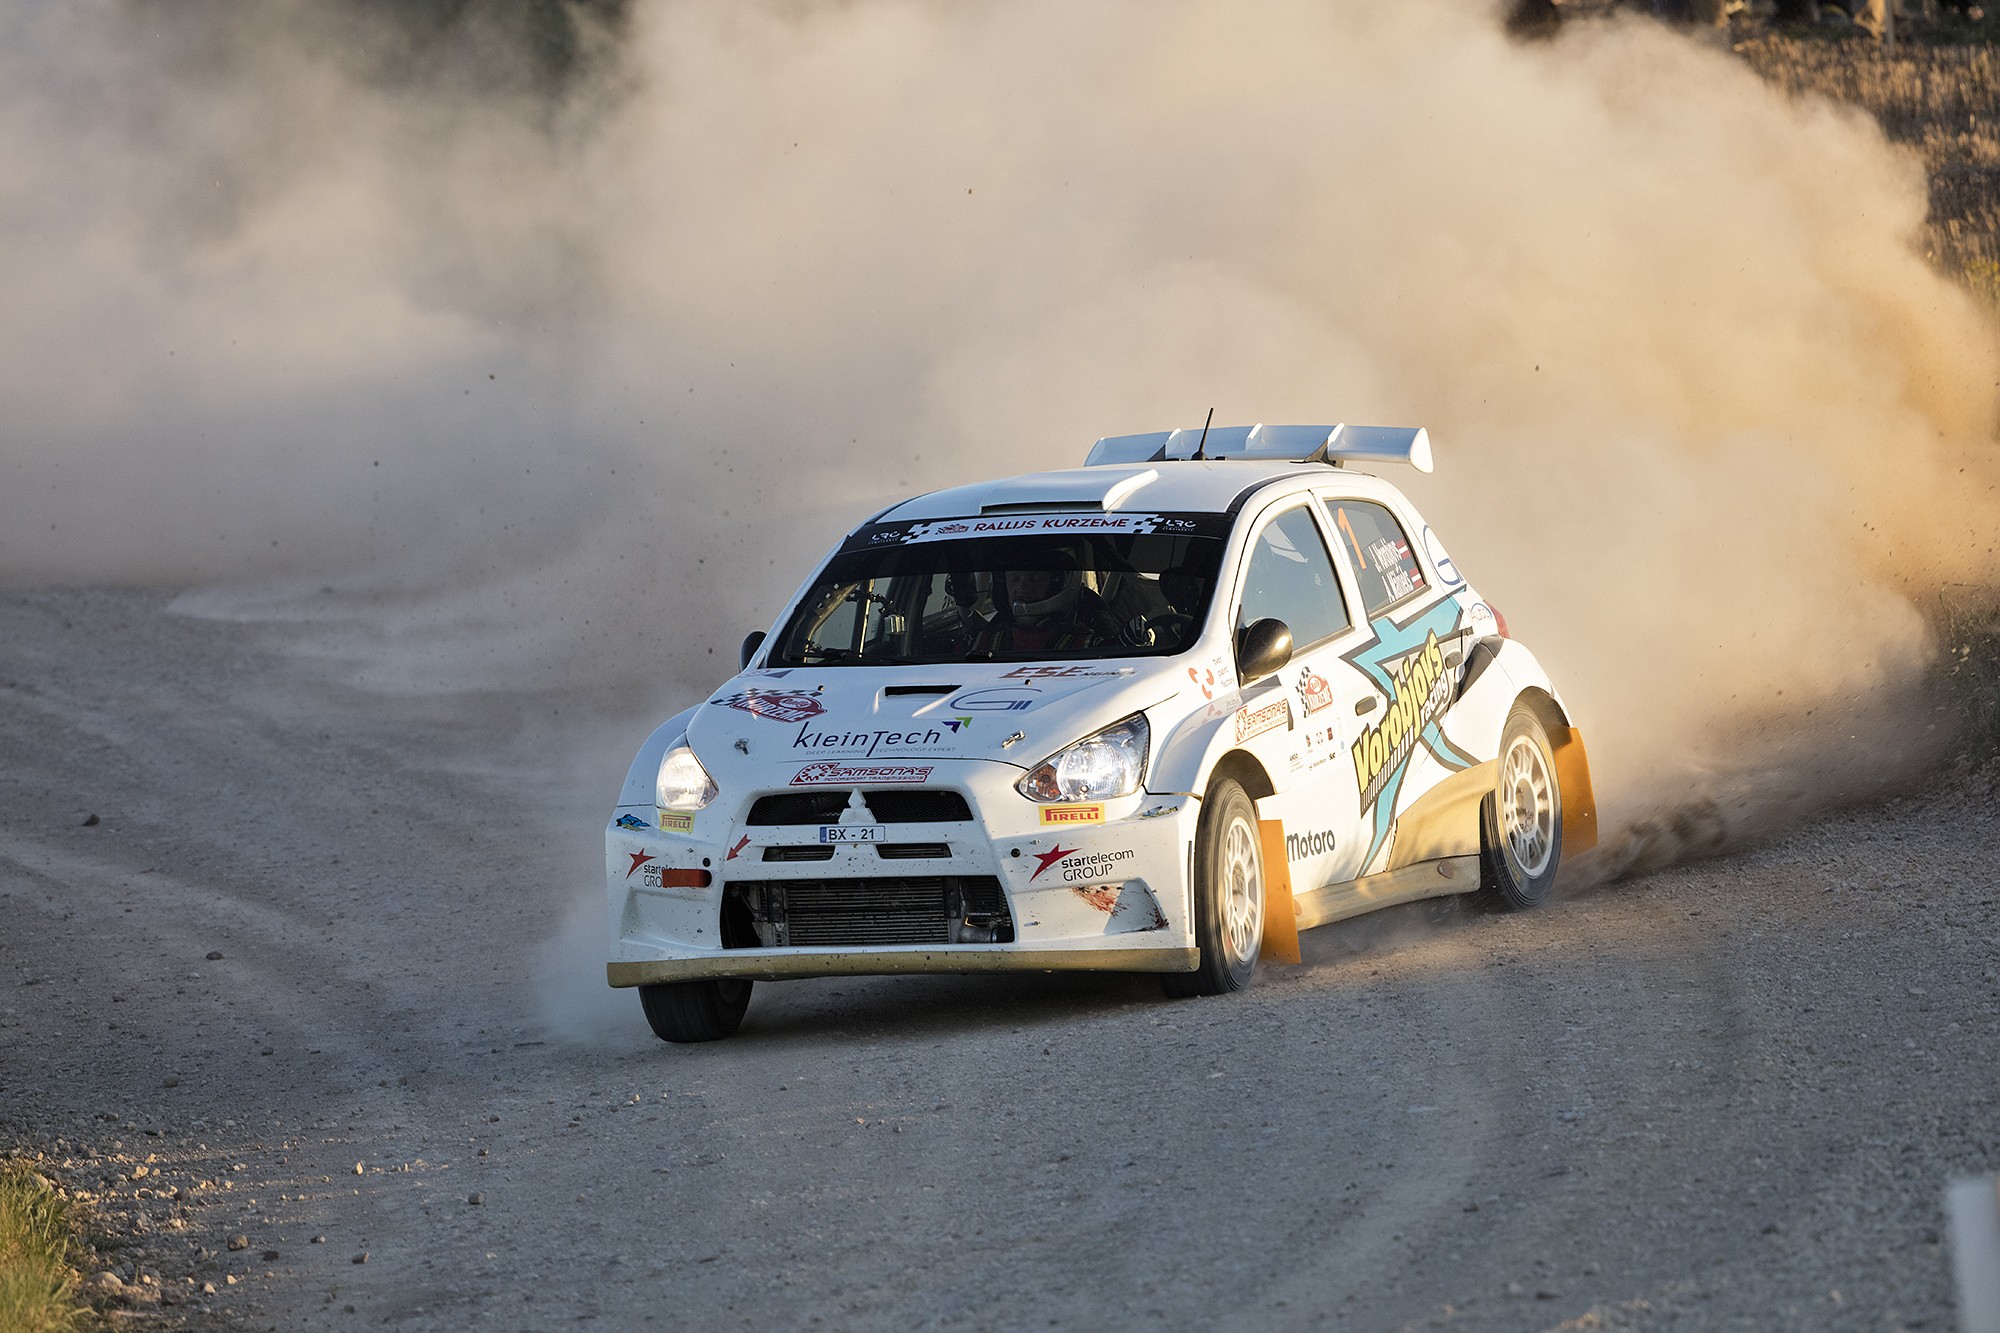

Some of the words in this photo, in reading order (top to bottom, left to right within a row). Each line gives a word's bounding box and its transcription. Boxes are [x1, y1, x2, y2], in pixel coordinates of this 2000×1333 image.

[974, 520, 1037, 532] RALLIJS
[1042, 518, 1129, 529] KURZEME
[1338, 508, 1367, 570] 1
[1352, 631, 1443, 794] Vorobjovs
[828, 767, 930, 777] SAMSONAS
[662, 814, 692, 829] PIRELLI
[1045, 807, 1100, 822] PIRELLI
[829, 827, 847, 840] BX
[861, 827, 875, 840] 21
[1062, 849, 1135, 869] startelecom
[1063, 863, 1113, 882] GROUP
